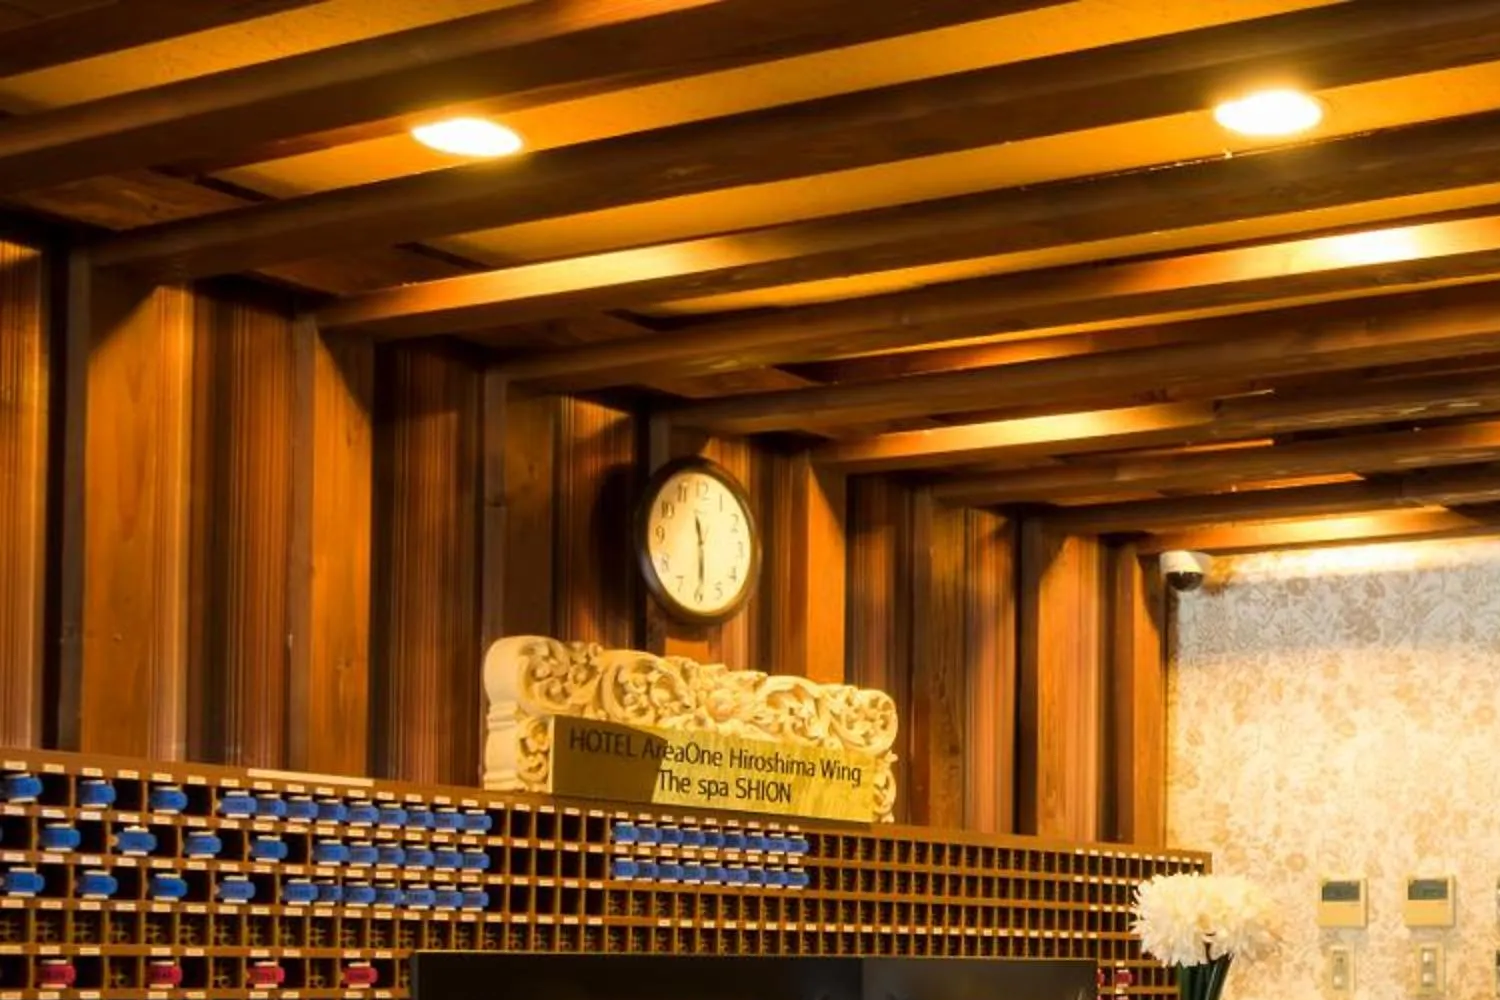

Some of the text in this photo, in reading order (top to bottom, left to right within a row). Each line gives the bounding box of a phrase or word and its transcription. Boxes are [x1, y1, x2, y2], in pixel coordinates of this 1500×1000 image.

[695, 479, 709, 502] 12
[661, 500, 675, 520] 10
[655, 525, 665, 545] 9
[675, 575, 684, 593] 7
[714, 580, 723, 601] 5
[569, 725, 862, 788] HOTEL AreaOne Hiroshima Wing
[656, 768, 793, 804] The spa SHION
